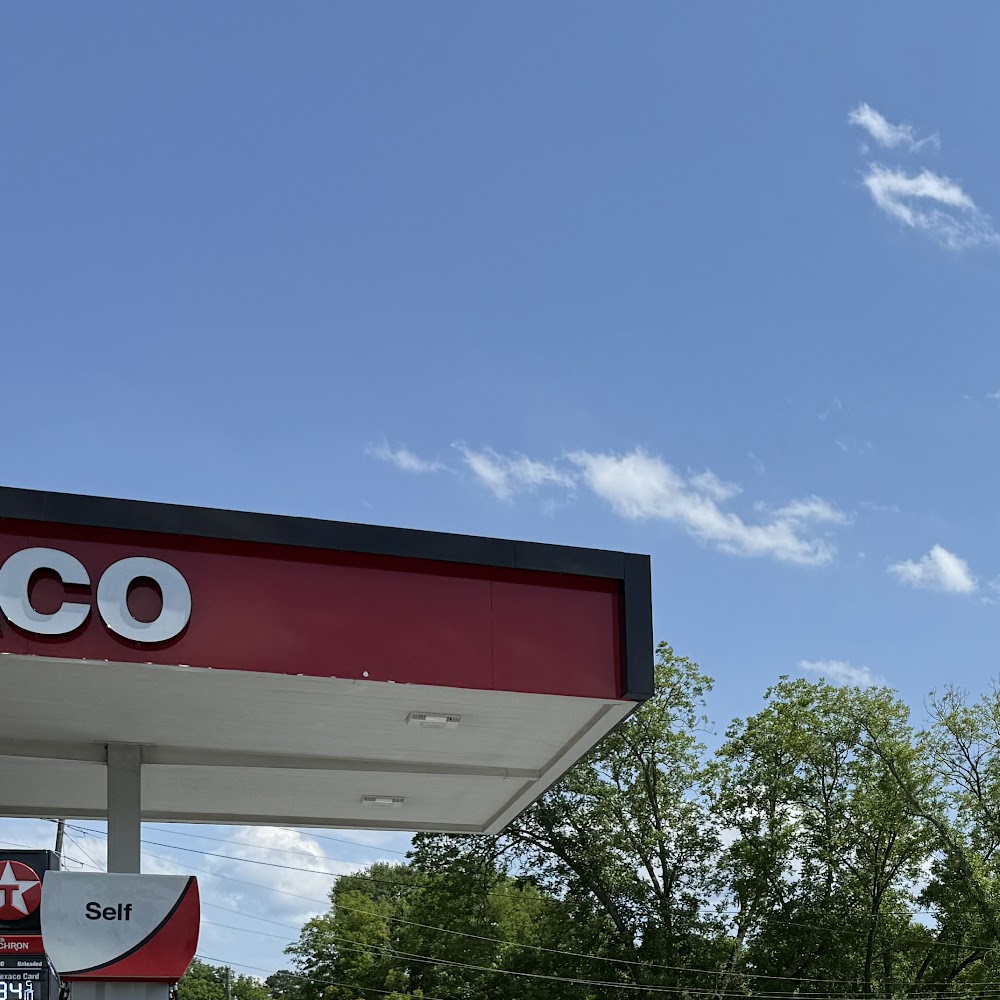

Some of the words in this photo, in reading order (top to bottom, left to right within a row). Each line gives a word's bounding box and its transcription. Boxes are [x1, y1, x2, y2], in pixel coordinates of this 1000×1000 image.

[0, 547, 192, 642] CO
[85, 901, 133, 921] Self
[22, 972, 40, 980] Card
